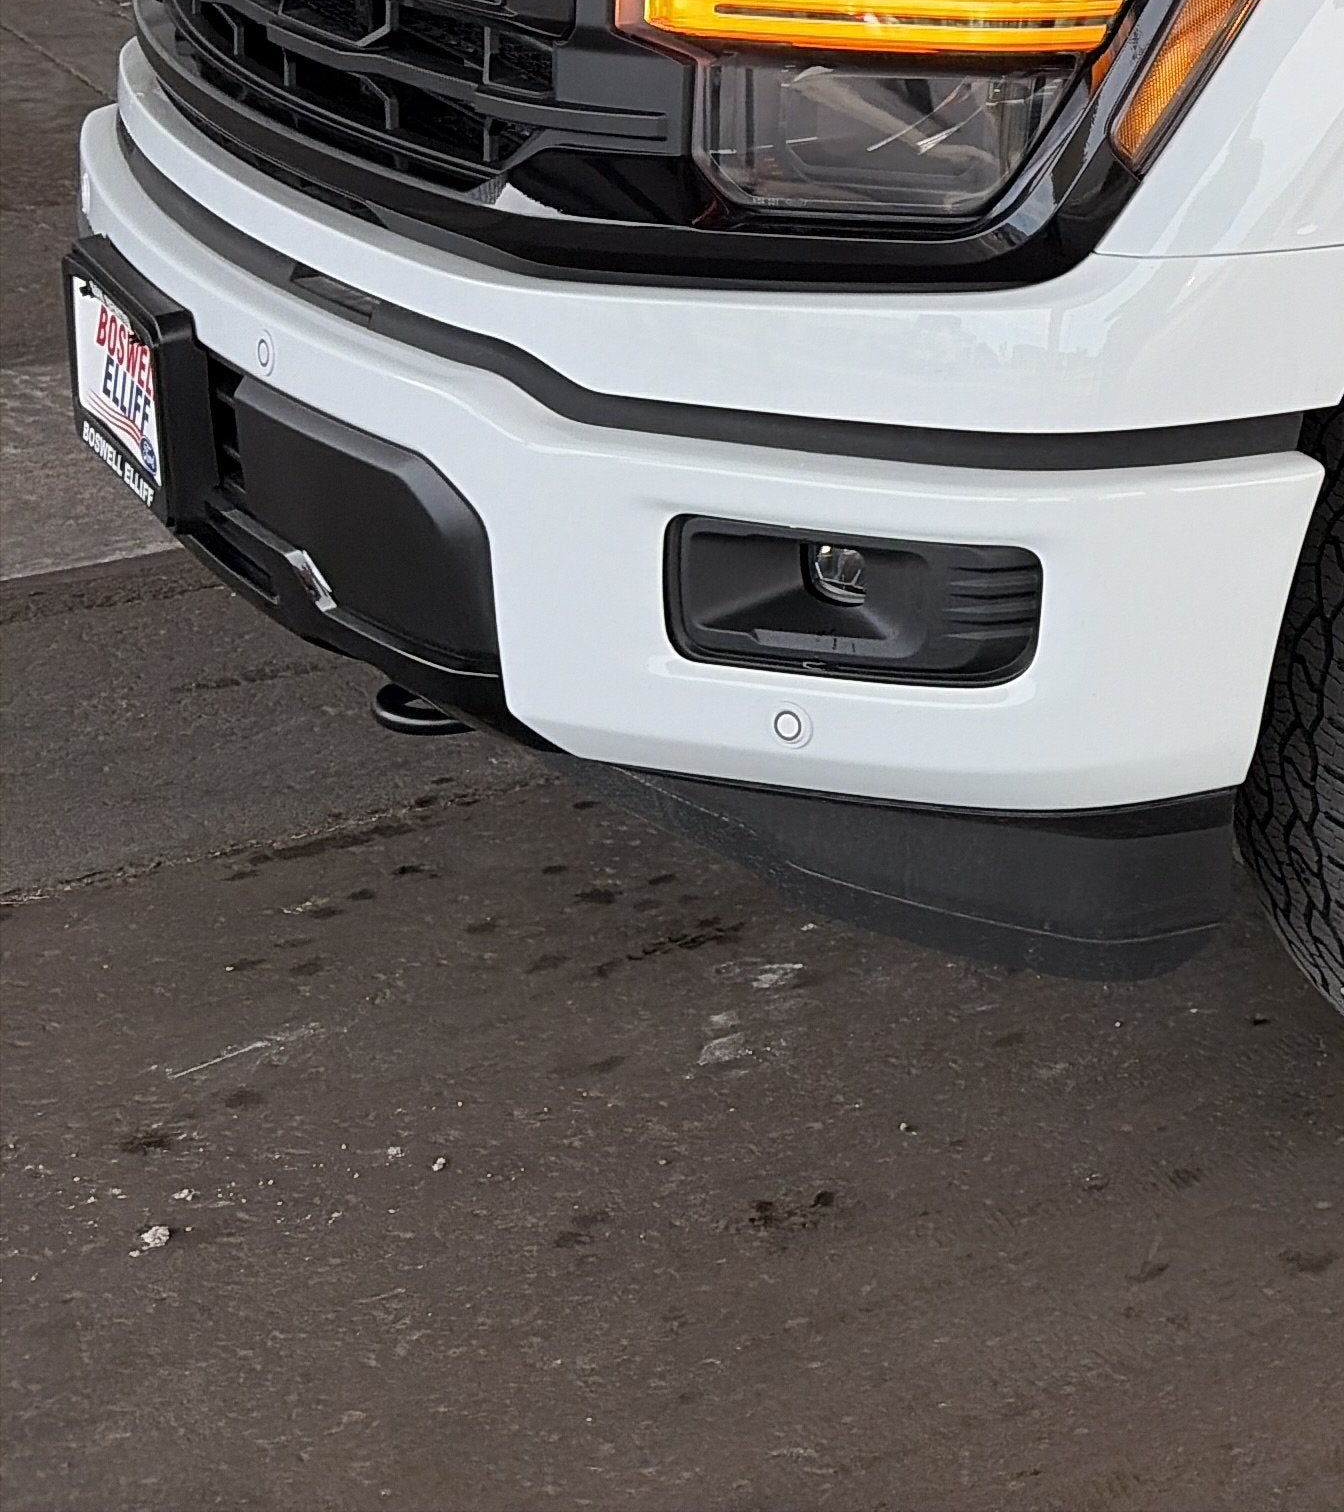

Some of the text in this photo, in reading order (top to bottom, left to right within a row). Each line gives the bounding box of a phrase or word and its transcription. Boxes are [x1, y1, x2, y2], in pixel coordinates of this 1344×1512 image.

[96, 304, 152, 397] BOSWEL
[102, 354, 151, 434] ELLIFF
[82, 420, 155, 507] BOSWELL ELLIFF
